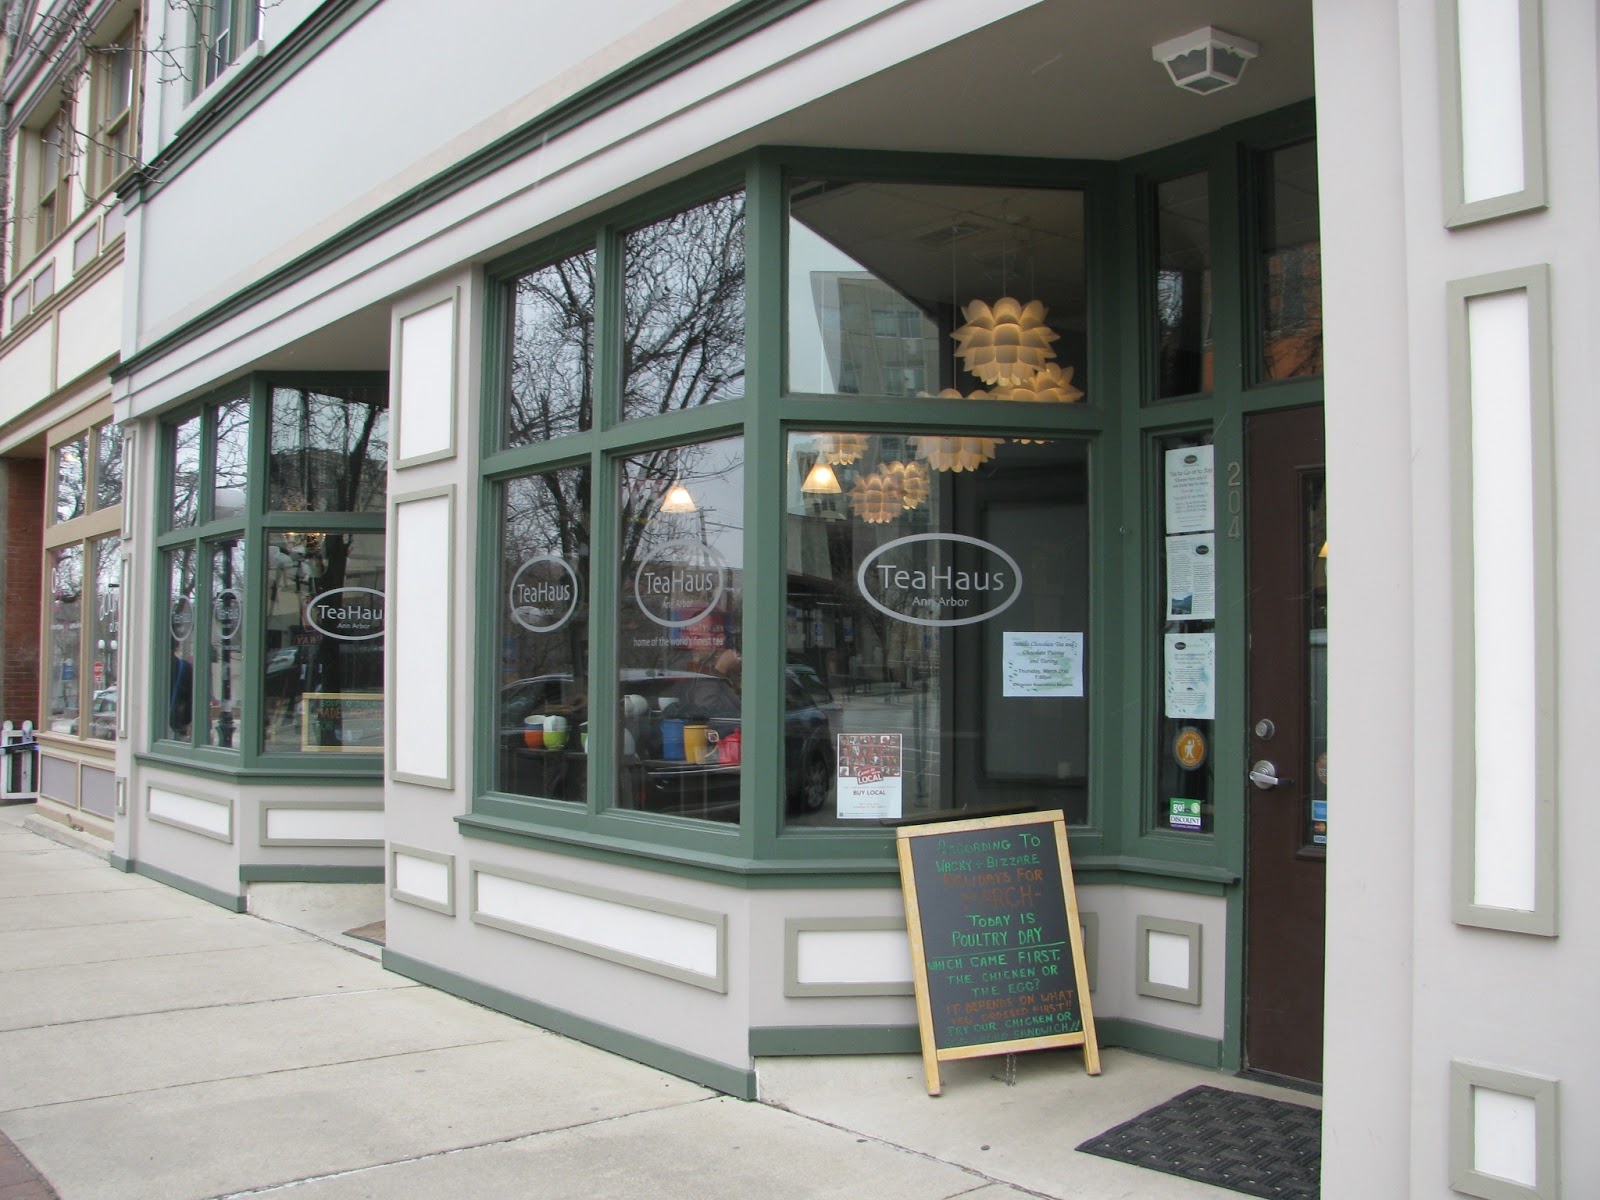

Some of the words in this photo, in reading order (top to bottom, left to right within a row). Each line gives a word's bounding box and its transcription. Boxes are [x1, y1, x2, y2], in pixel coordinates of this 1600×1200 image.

[1228, 461, 1241, 538] 204
[644, 570, 713, 594] TeaHaus
[877, 565, 1004, 591] TeaHaus
[517, 582, 570, 603] TeaHaus
[675, 598, 693, 608] Arbor
[912, 597, 936, 606] Ann
[938, 597, 969, 607] Arbor
[317, 605, 384, 620] TeaHau
[633, 637, 650, 647] home
[651, 637, 658, 647] of
[659, 637, 669, 647] the
[670, 636, 692, 648] world's
[693, 636, 712, 647] finest
[858, 774, 882, 783] LOCAL
[1170, 816, 1200, 824] DISCOUNT
[1019, 833, 1041, 847] TO
[936, 859, 972, 873] WACKY
[987, 854, 1040, 869] BIZZARE
[1016, 868, 1044, 882] FOR
[965, 914, 1011, 928] TODAY
[1020, 913, 1036, 924] IS
[952, 931, 1007, 947] POULTRY
[1018, 927, 1042, 943] DAY
[928, 957, 963, 971] WHICH
[970, 954, 1007, 968] CAME
[947, 975, 974, 985] THE
[982, 967, 1036, 982] CHICKEN
[1042, 964, 1058, 976] OR
[972, 986, 998, 997] THE
[1008, 980, 1040, 993] EGG?
[947, 1004, 961, 1015] IT
[965, 998, 1013, 1012] DEPENDS
[1019, 995, 1035, 1005] ON
[1040, 990, 1073, 1000] WHAT
[946, 1026, 968, 1037] TRY
[973, 1022, 996, 1032] OUR
[1005, 1014, 1053, 1028] CHICKEN
[1057, 1011, 1071, 1022] OR
